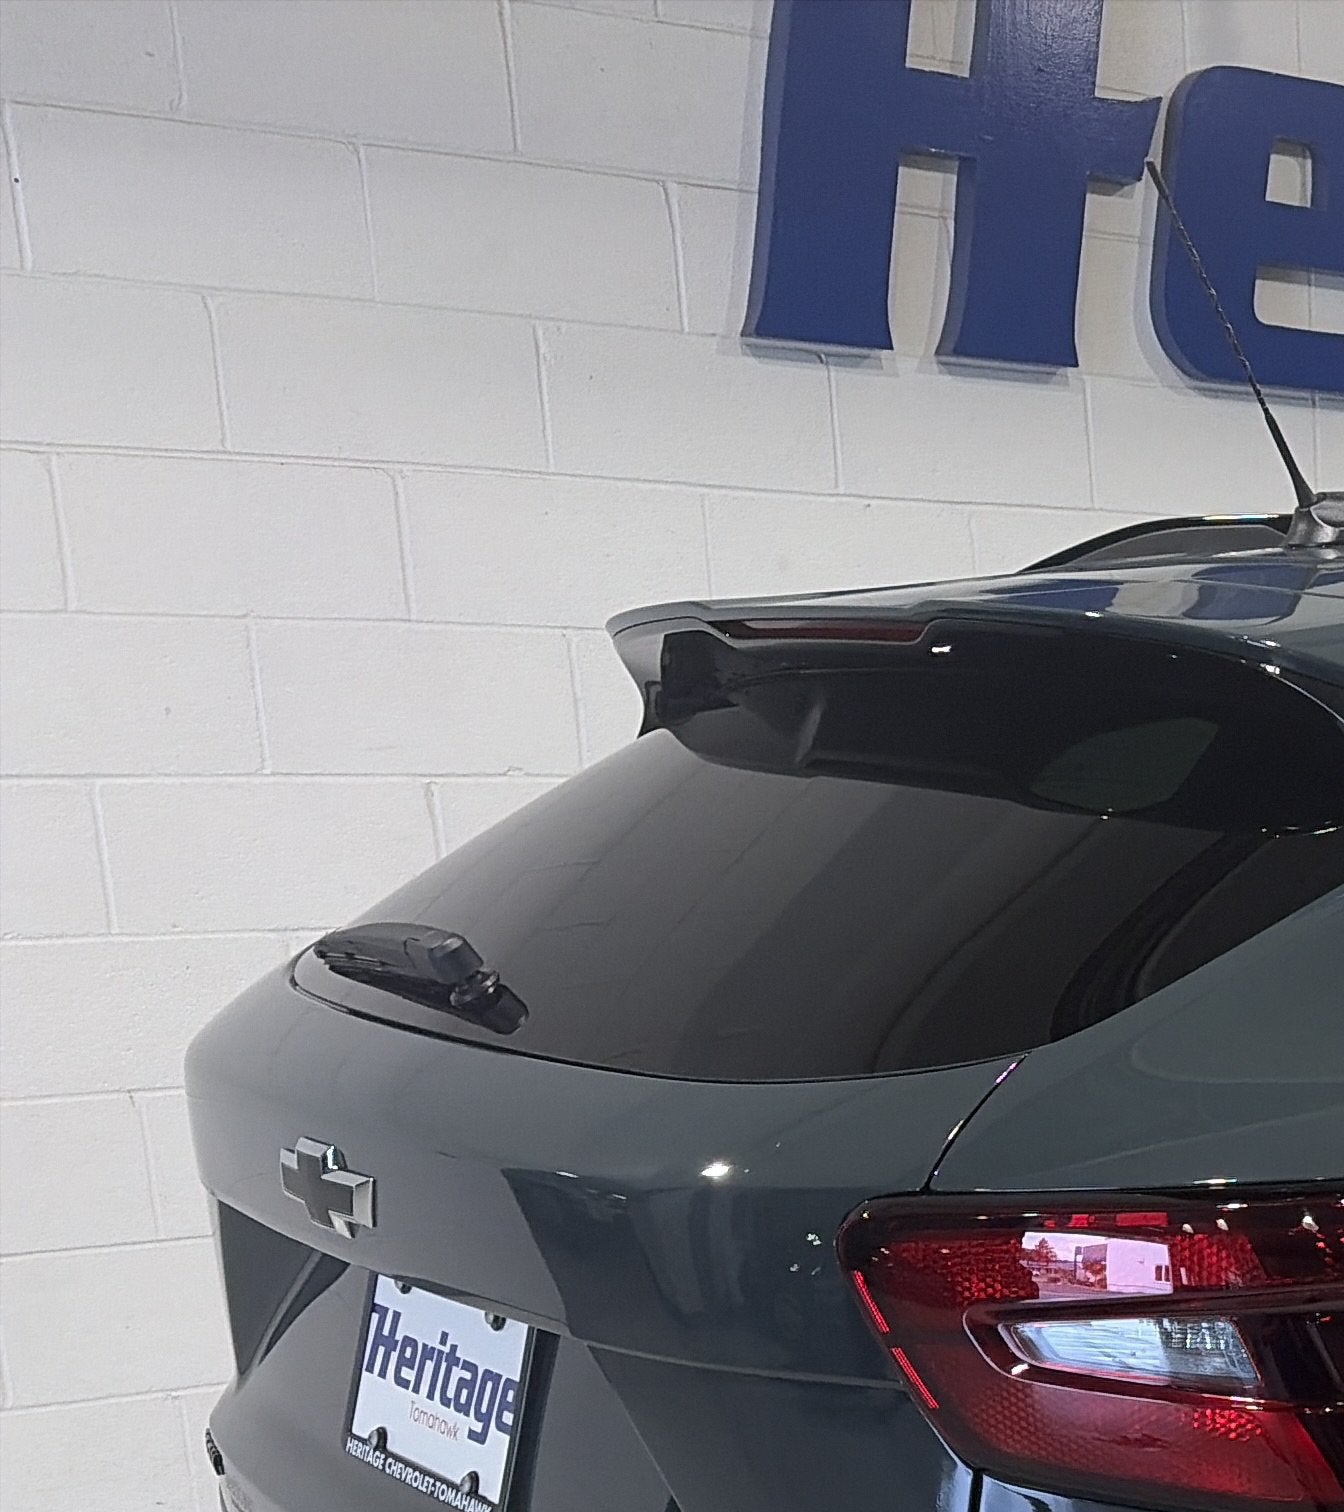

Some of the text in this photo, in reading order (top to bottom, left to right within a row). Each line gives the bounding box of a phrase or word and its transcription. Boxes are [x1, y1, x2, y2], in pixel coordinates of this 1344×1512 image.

[365, 1303, 519, 1445] Heritage
[410, 1400, 460, 1441] Tomahawk
[345, 1437, 386, 1470] HERITAGE
